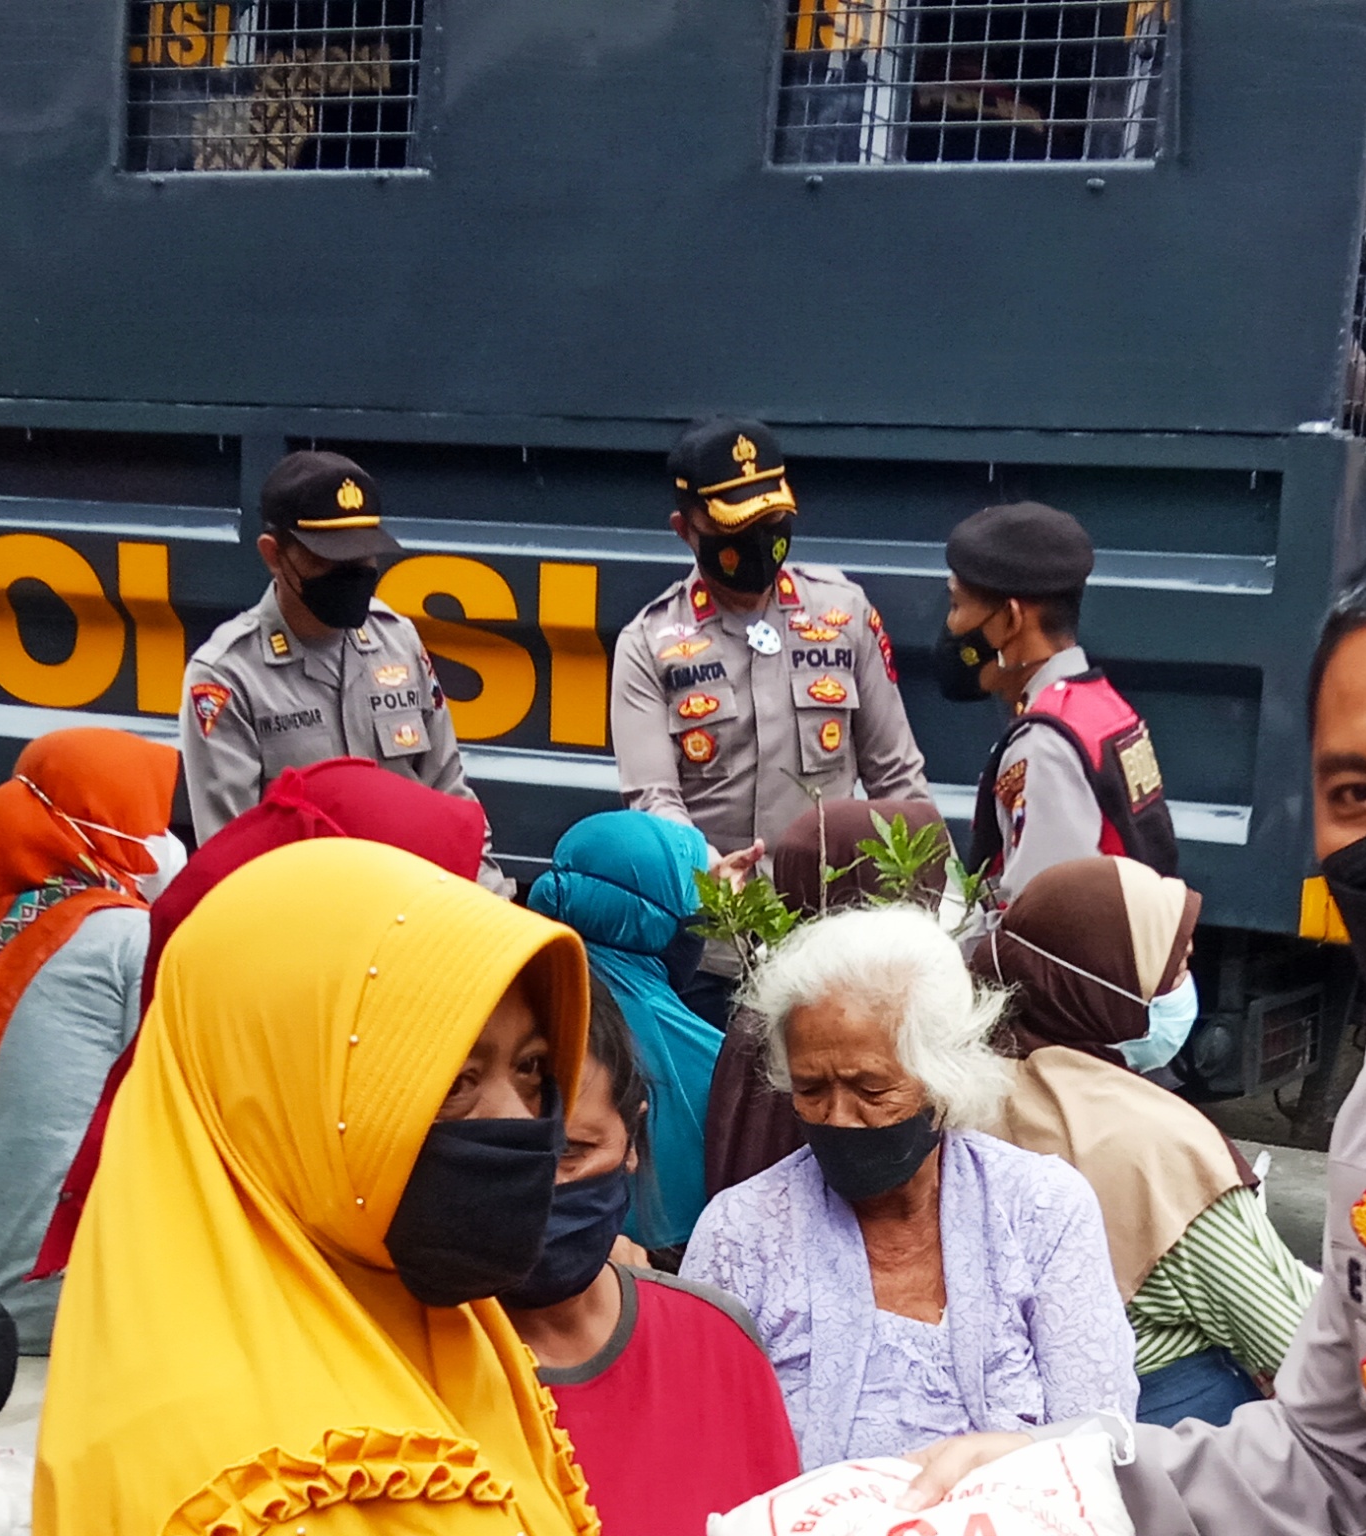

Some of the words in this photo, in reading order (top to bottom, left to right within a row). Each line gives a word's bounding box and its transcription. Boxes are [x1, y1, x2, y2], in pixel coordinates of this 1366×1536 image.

[792, 649, 852, 668] POLRI
[370, 689, 420, 713] POLRI
[791, 1484, 887, 1533] BERAS
